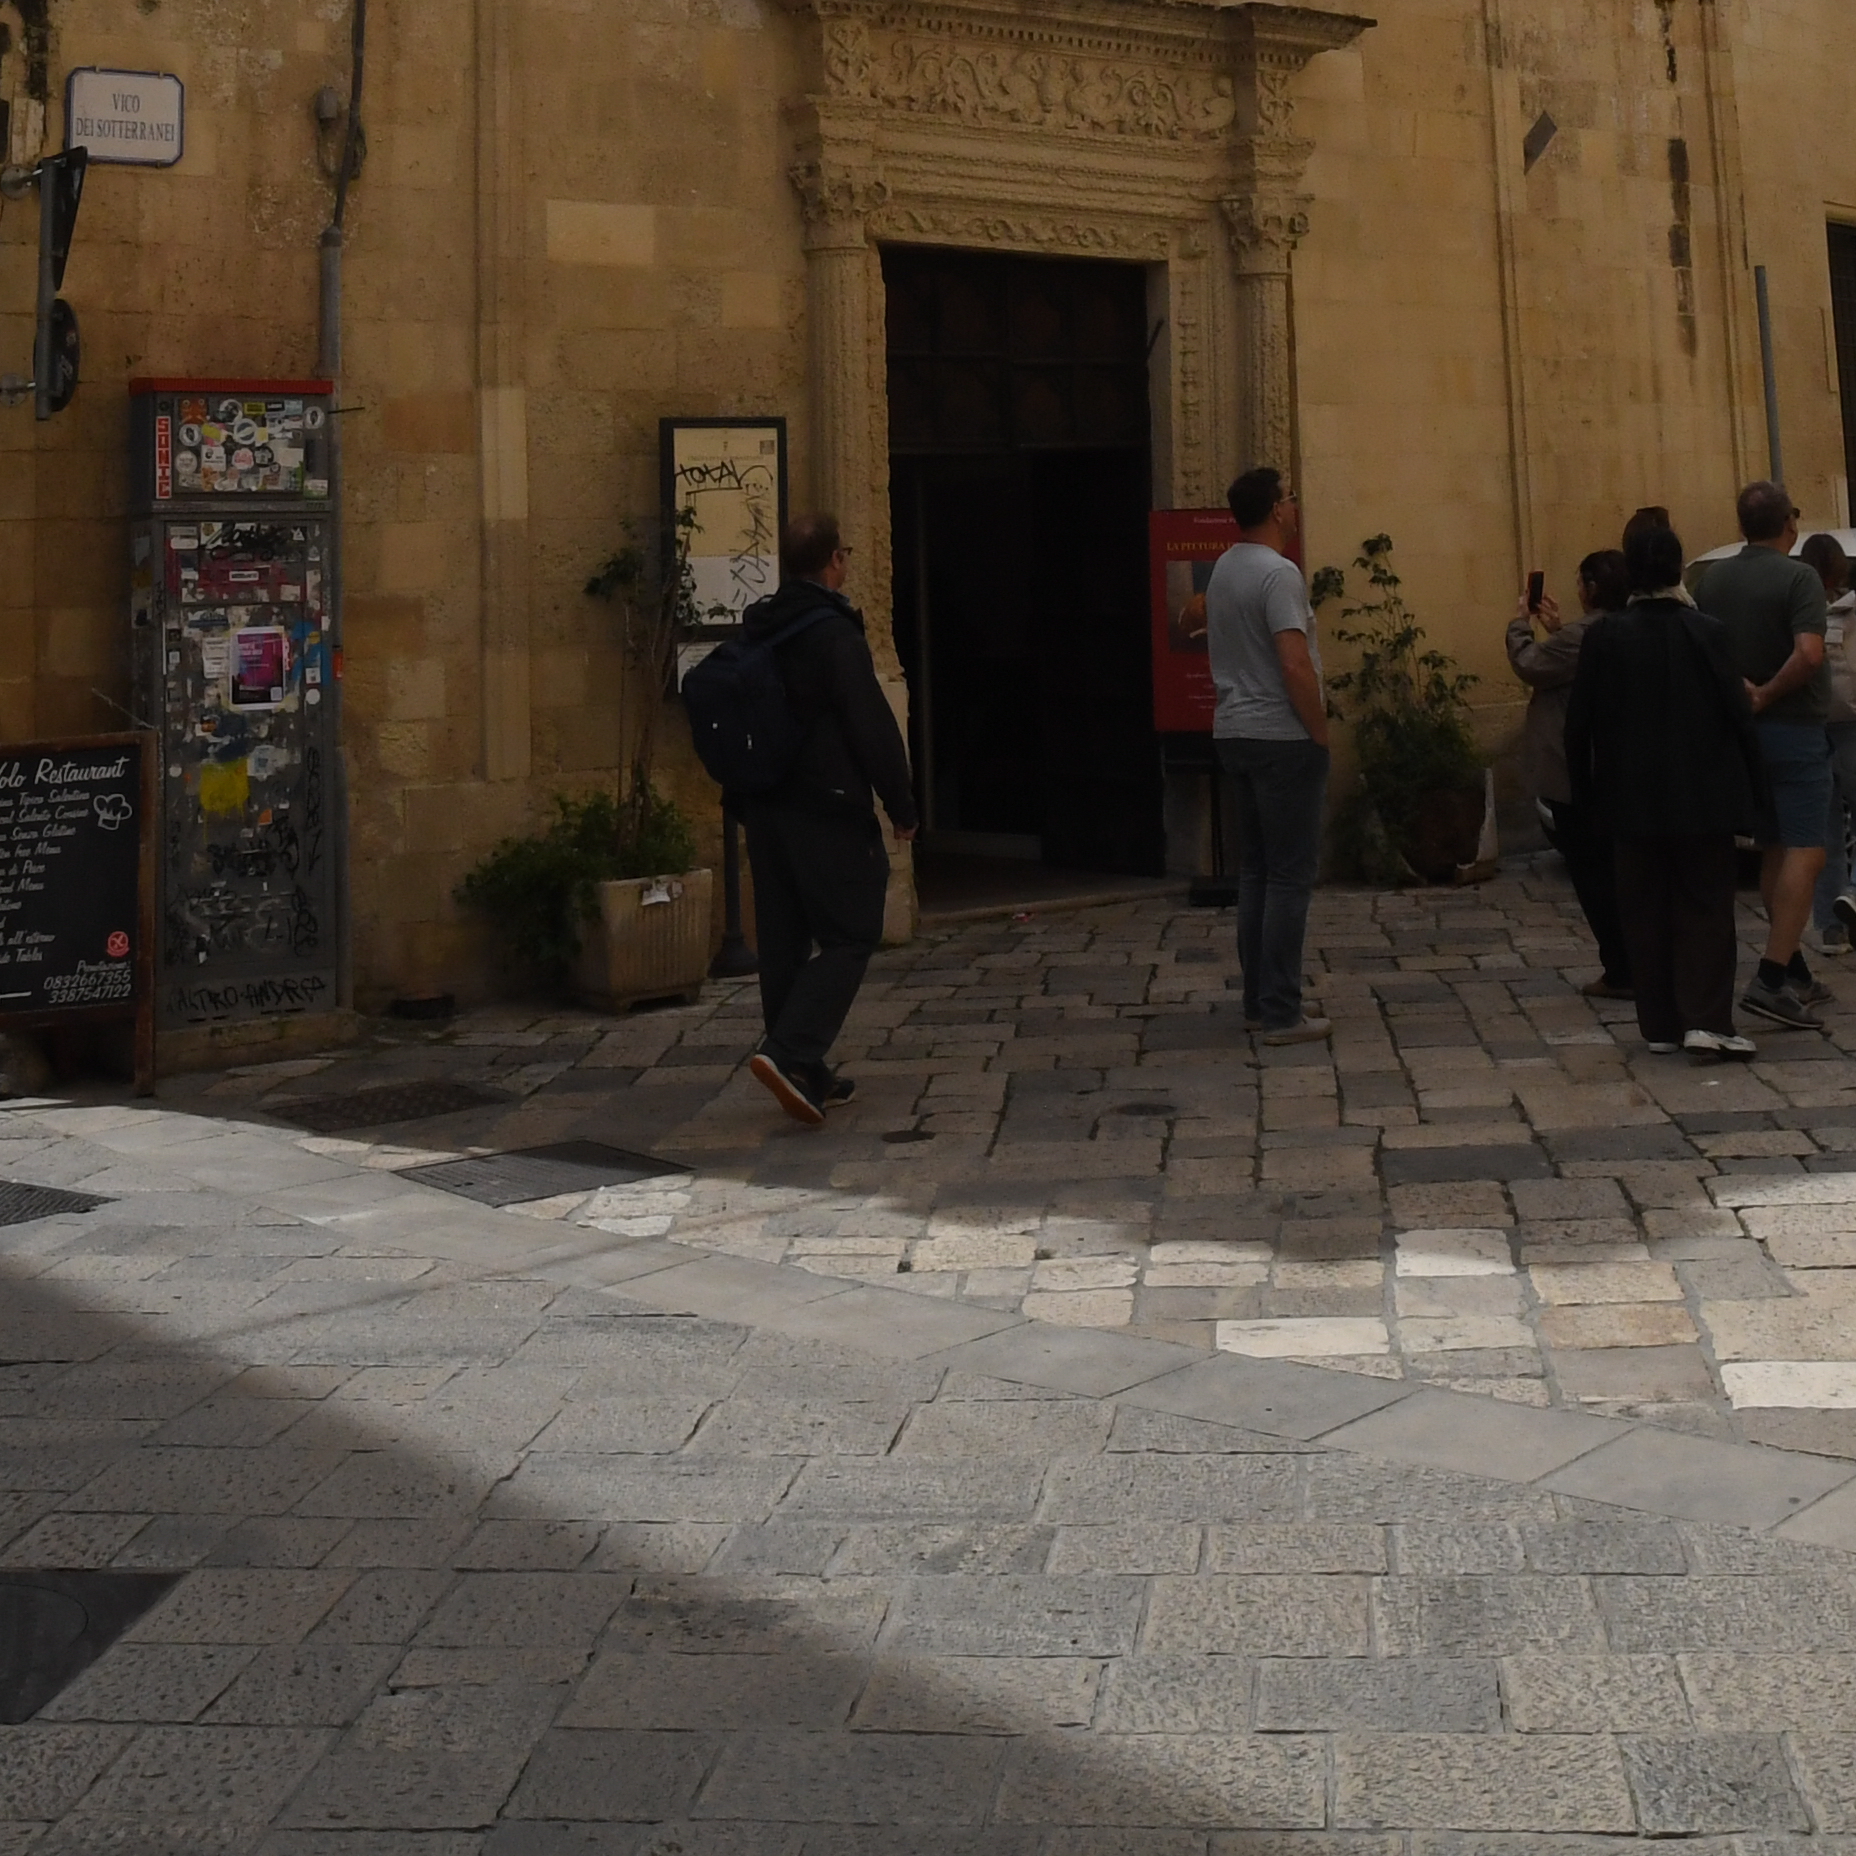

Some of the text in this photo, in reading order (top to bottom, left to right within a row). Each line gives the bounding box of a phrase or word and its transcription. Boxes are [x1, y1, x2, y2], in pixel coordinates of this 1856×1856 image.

[112, 93, 141, 114] VICO
[76, 118, 175, 143] DEI SOTTERRANEI
[158, 417, 171, 497] SONIC
[34, 756, 131, 785] Restaurant
[43, 969, 132, 991] 0832667355
[48, 983, 132, 1004] 3387547122
